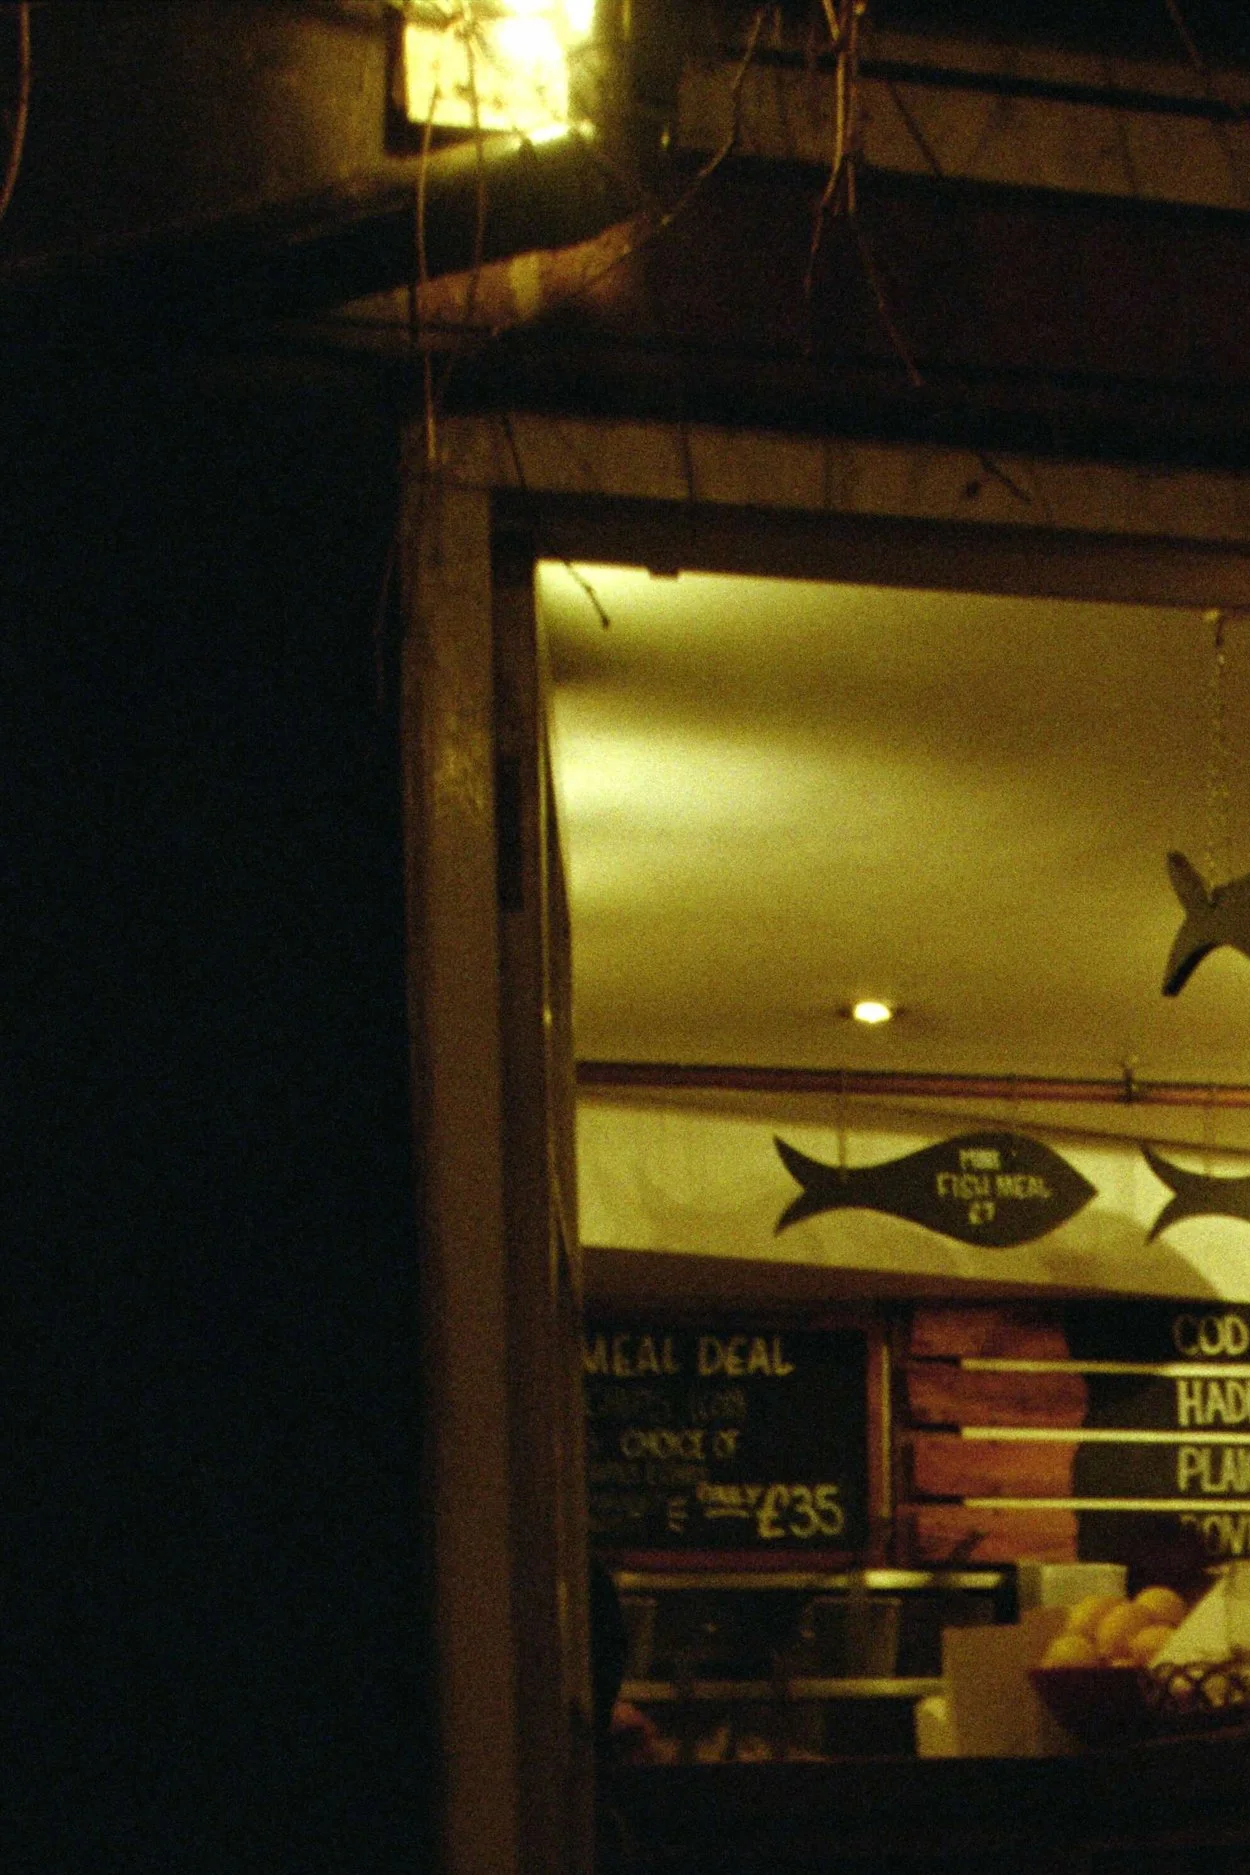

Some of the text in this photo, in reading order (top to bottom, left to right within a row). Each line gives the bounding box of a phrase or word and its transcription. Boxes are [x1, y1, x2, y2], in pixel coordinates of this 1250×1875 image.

[936, 1171, 1051, 1200] FISH MEAL
[583, 1333, 796, 1377] MEAL DEAL
[1173, 1314, 1250, 1356] COD
[756, 1482, 846, 1539] £35
